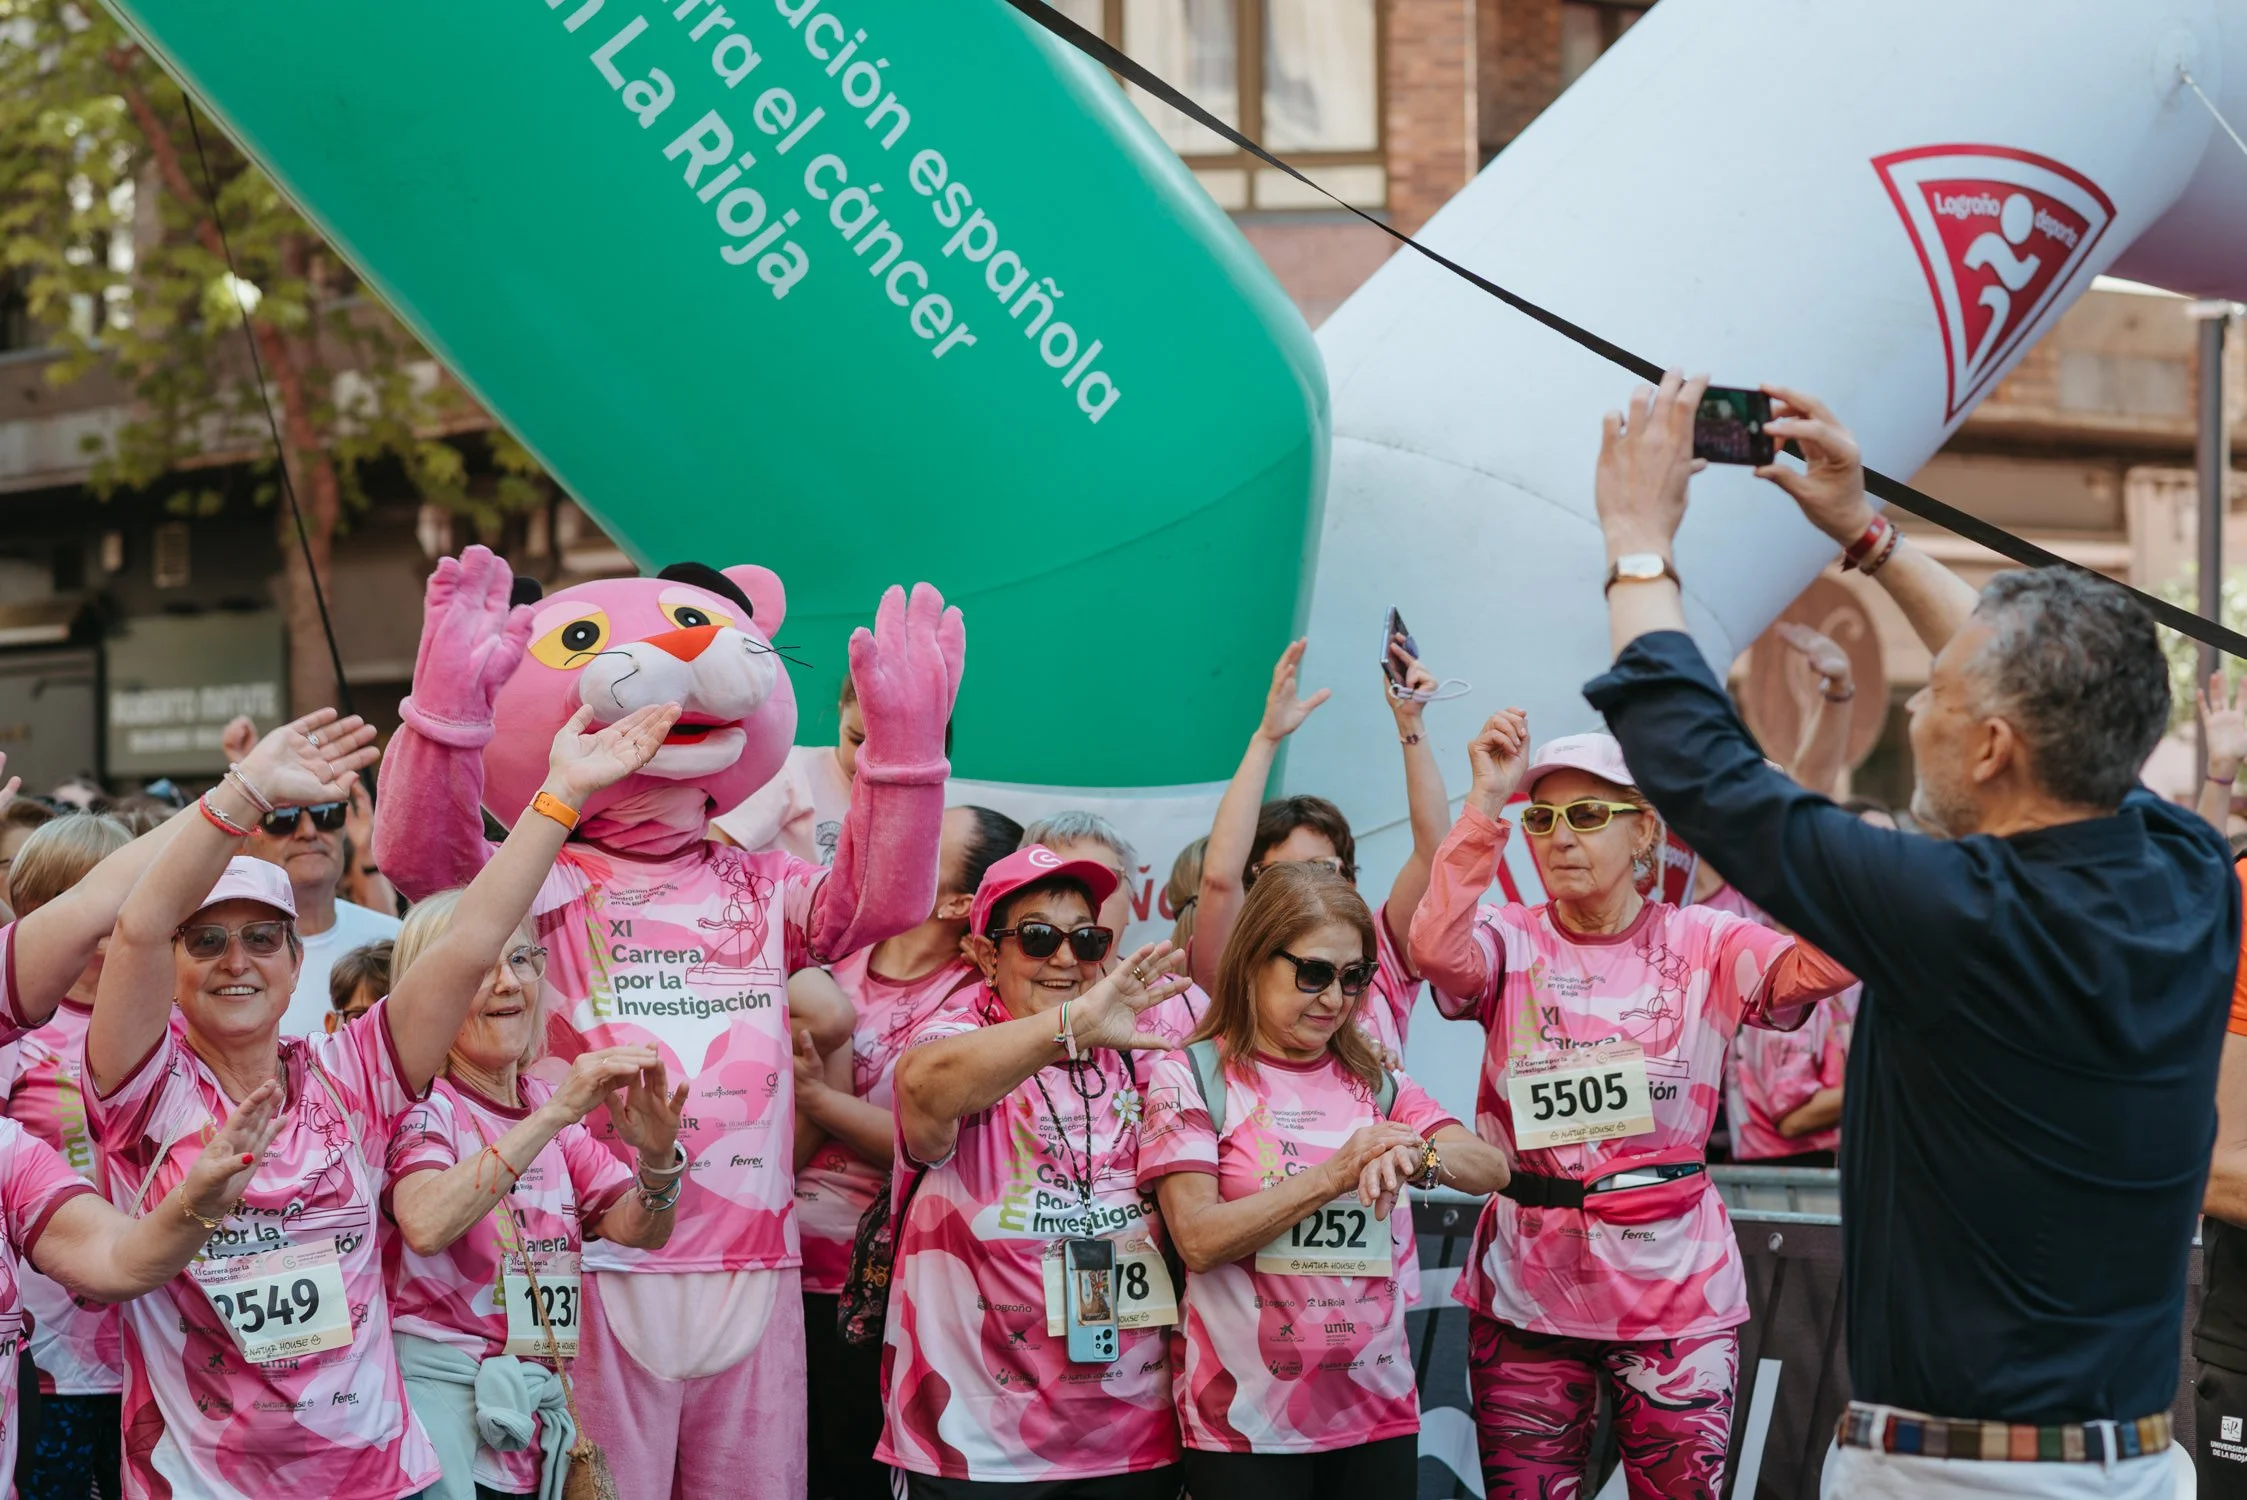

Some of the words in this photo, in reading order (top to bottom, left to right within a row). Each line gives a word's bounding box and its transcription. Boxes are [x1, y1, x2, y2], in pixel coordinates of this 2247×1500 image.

[591, 15, 675, 129] La
[663, 110, 809, 299] Rioja
[1933, 191, 2000, 220] Logroño
[754, 87, 824, 155] el
[804, 154, 976, 358] cáncer
[909, 149, 1119, 423] española
[608, 919, 633, 938] XI
[611, 944, 703, 964] Carrera
[614, 973, 654, 994] por
[659, 971, 683, 990] la
[617, 989, 772, 1019] Investigación
[1540, 1006, 1559, 1026] XI
[1530, 1072, 1629, 1121] 5505
[1279, 1140, 1299, 1157] XI
[730, 1155, 763, 1168] Ferrer
[254, 1222, 281, 1242] la
[1291, 1209, 1367, 1249] 1252
[1621, 1228, 1655, 1241] Ferrer
[202, 1267, 229, 1277] Carrera
[229, 1265, 242, 1275] por
[242, 1264, 250, 1272] la
[1115, 1262, 1150, 1300] 78
[989, 1301, 1033, 1314] Logroño
[1317, 1299, 1327, 1307] La
[1327, 1297, 1345, 1309] Rioja
[279, 1337, 310, 1352] HOUSE
